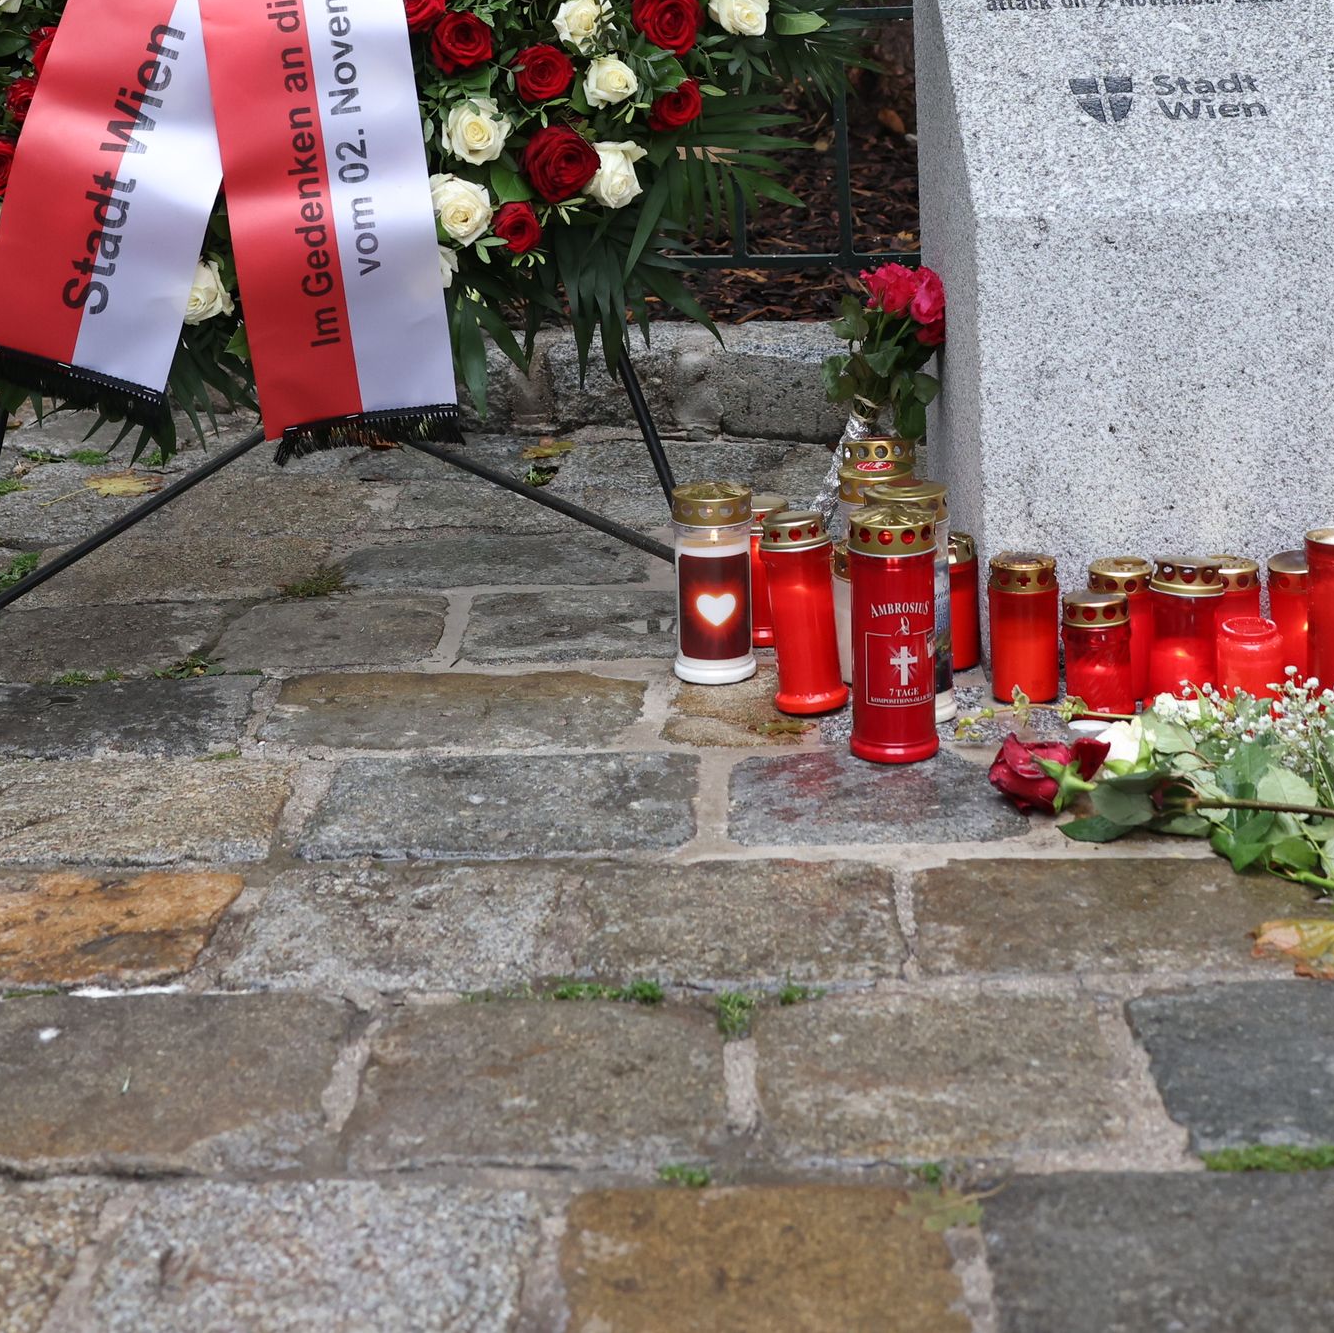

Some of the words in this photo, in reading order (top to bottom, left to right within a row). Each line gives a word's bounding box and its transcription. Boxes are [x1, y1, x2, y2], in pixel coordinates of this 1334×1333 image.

[98, 22, 187, 156] Wien
[282, 46, 309, 93] an
[1152, 72, 1260, 96] Stadt
[1157, 97, 1268, 120] Wien
[335, 128, 370, 184] 02.
[287, 106, 334, 298] Gedenken
[61, 169, 137, 316] Stadt
[351, 196, 381, 277] vom
[310, 306, 341, 348] Im
[870, 600, 930, 619] AMBROSIUS
[888, 687, 894, 697] 7
[895, 686, 920, 698] TAGE
